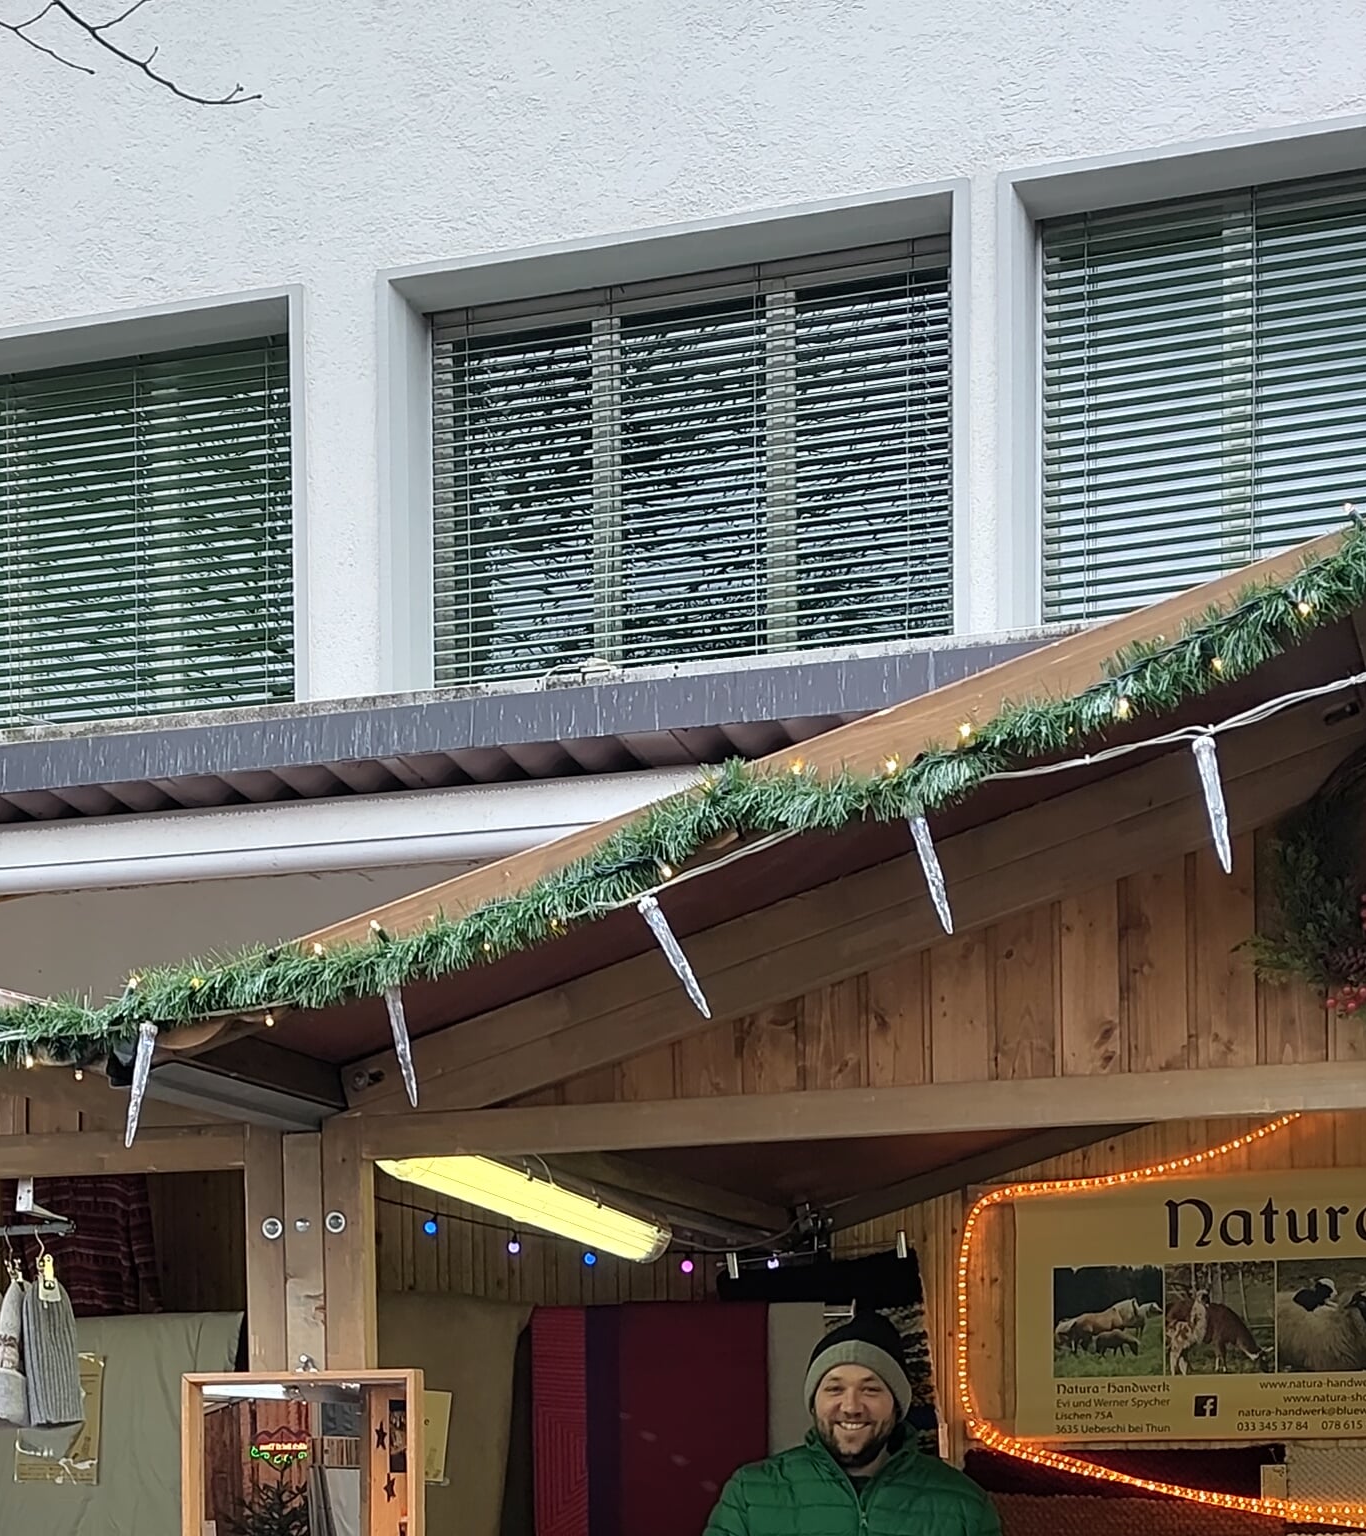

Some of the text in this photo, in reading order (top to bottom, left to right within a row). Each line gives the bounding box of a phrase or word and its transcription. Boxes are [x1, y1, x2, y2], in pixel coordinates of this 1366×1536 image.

[1056, 1397, 1171, 1409] Evi und Werner Spycher
[1055, 1411, 1113, 1421] Lischen 75A
[1055, 1423, 1171, 1434] 3635 Uebeschi bei Thun
[1237, 1421, 1256, 1431] 033
[1258, 1421, 1278, 1431] 345
[1280, 1421, 1293, 1431] 37
[1295, 1421, 1309, 1431] 84
[1321, 1420, 1341, 1431] 078
[1343, 1420, 1363, 1430] 615
